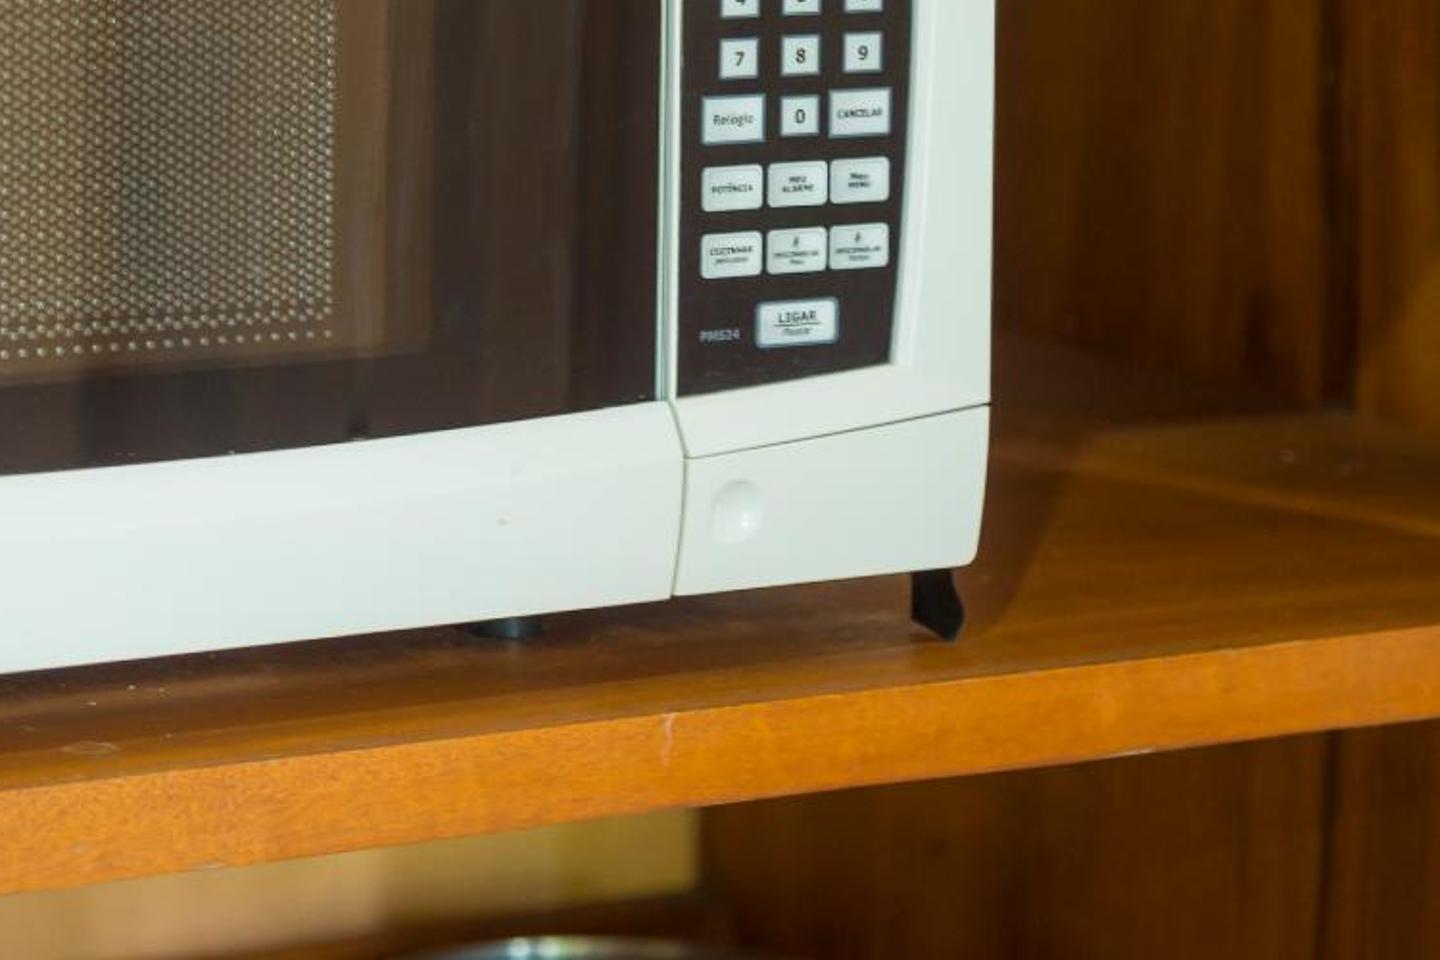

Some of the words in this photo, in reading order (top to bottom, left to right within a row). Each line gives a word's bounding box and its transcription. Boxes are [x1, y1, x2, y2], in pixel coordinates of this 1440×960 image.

[734, 51, 745, 67] 7
[795, 48, 806, 63] 8
[857, 45, 868, 60] 9
[794, 109, 806, 124] 0
[836, 106, 883, 120] CANCELAR
[777, 309, 817, 324] LIGAR
